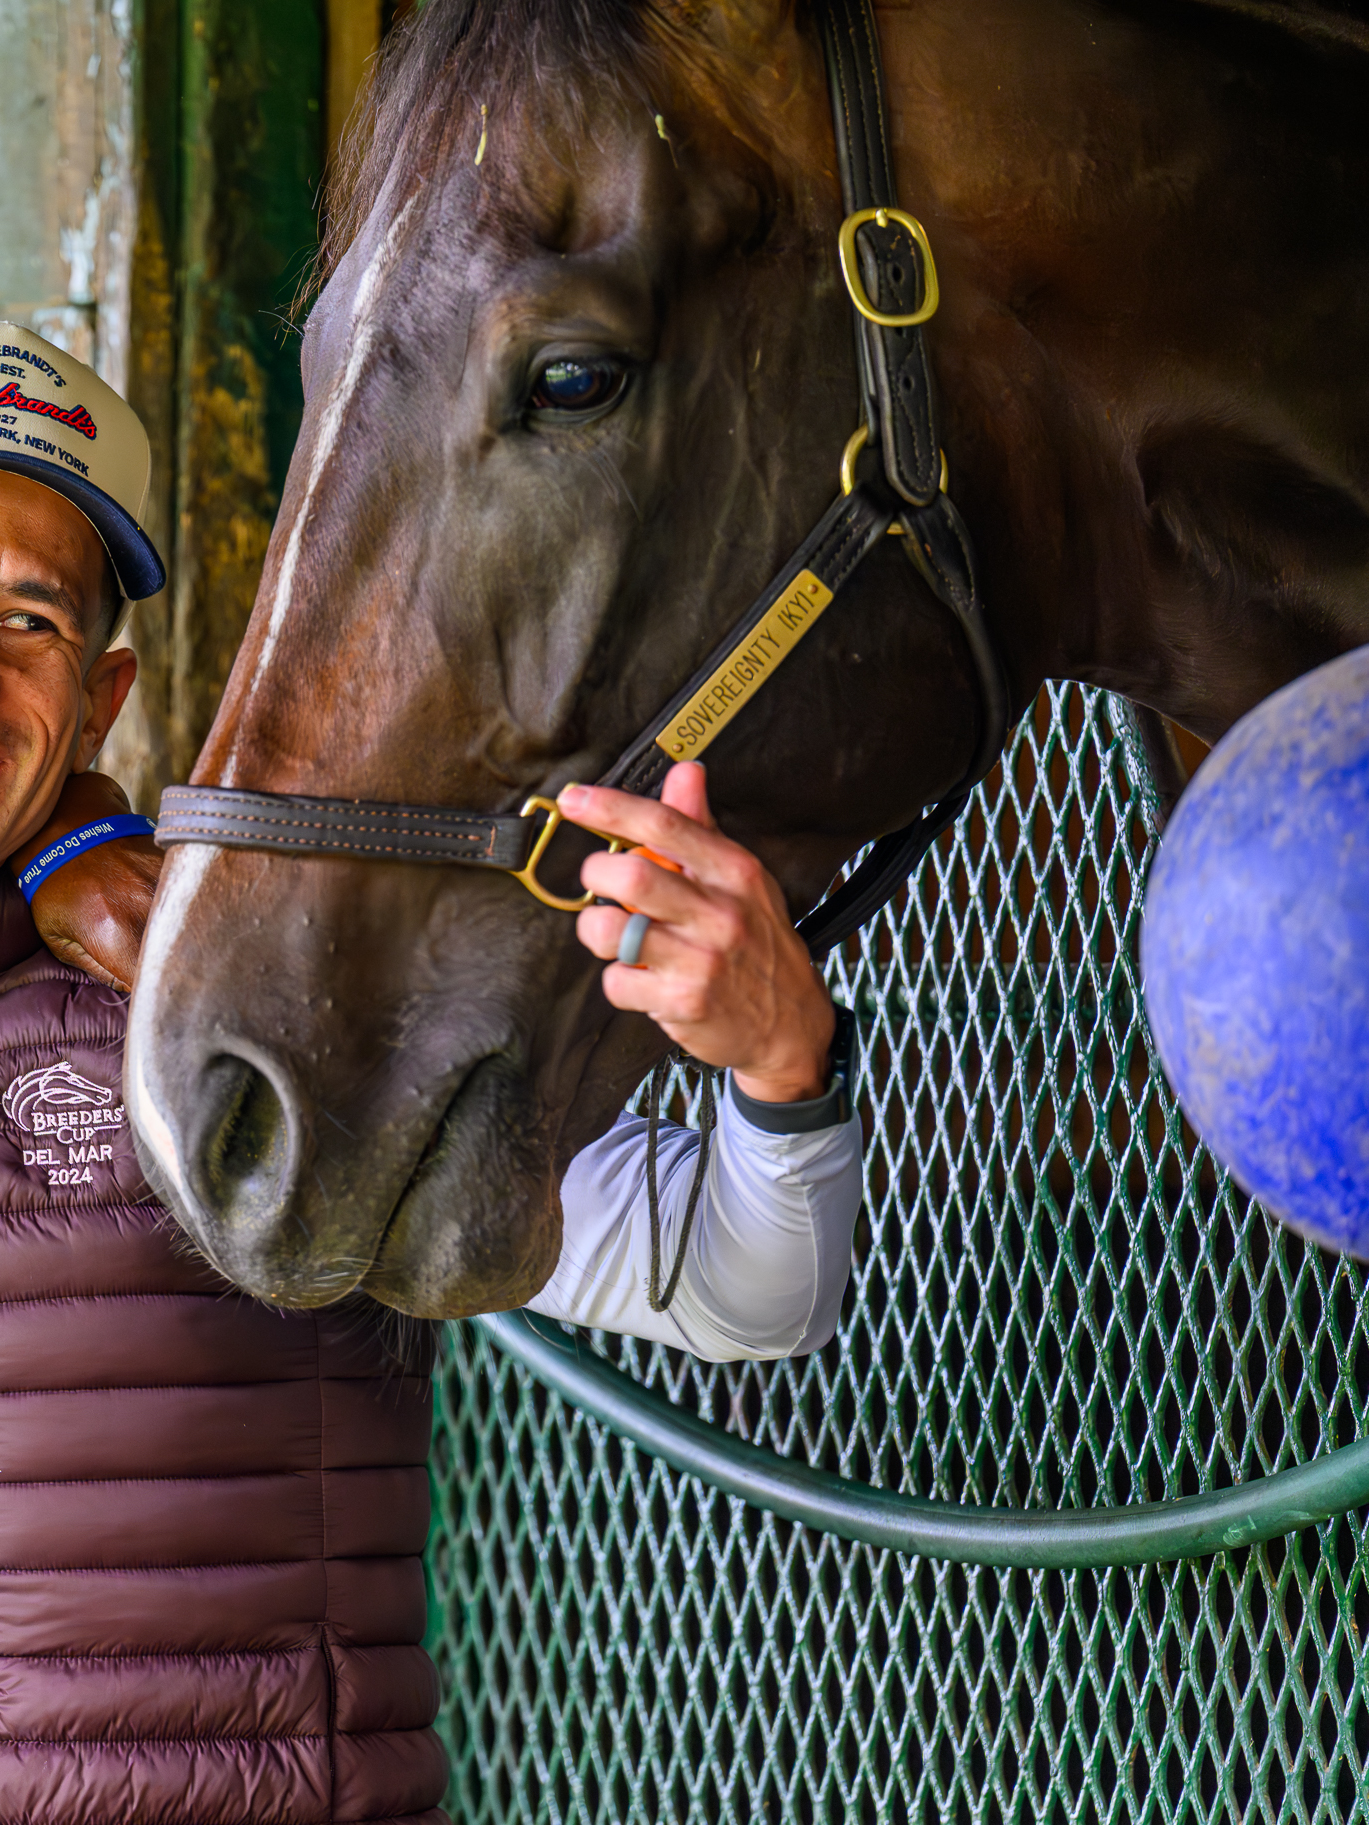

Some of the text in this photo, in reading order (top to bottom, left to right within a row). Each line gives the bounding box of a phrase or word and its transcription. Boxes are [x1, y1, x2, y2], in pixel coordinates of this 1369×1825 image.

[0, 362, 26, 380] EST.
[24, 434, 57, 456] NEW
[57, 447, 90, 478] YORK
[676, 626, 781, 746] SOVEREIGNTY
[23, 822, 115, 884] Wishes Do Come True
[31, 1104, 125, 1132] BREEDERS'
[56, 1126, 96, 1145] CUP
[22, 1144, 113, 1166] DEL MAR
[47, 1166, 93, 1185] 2024
